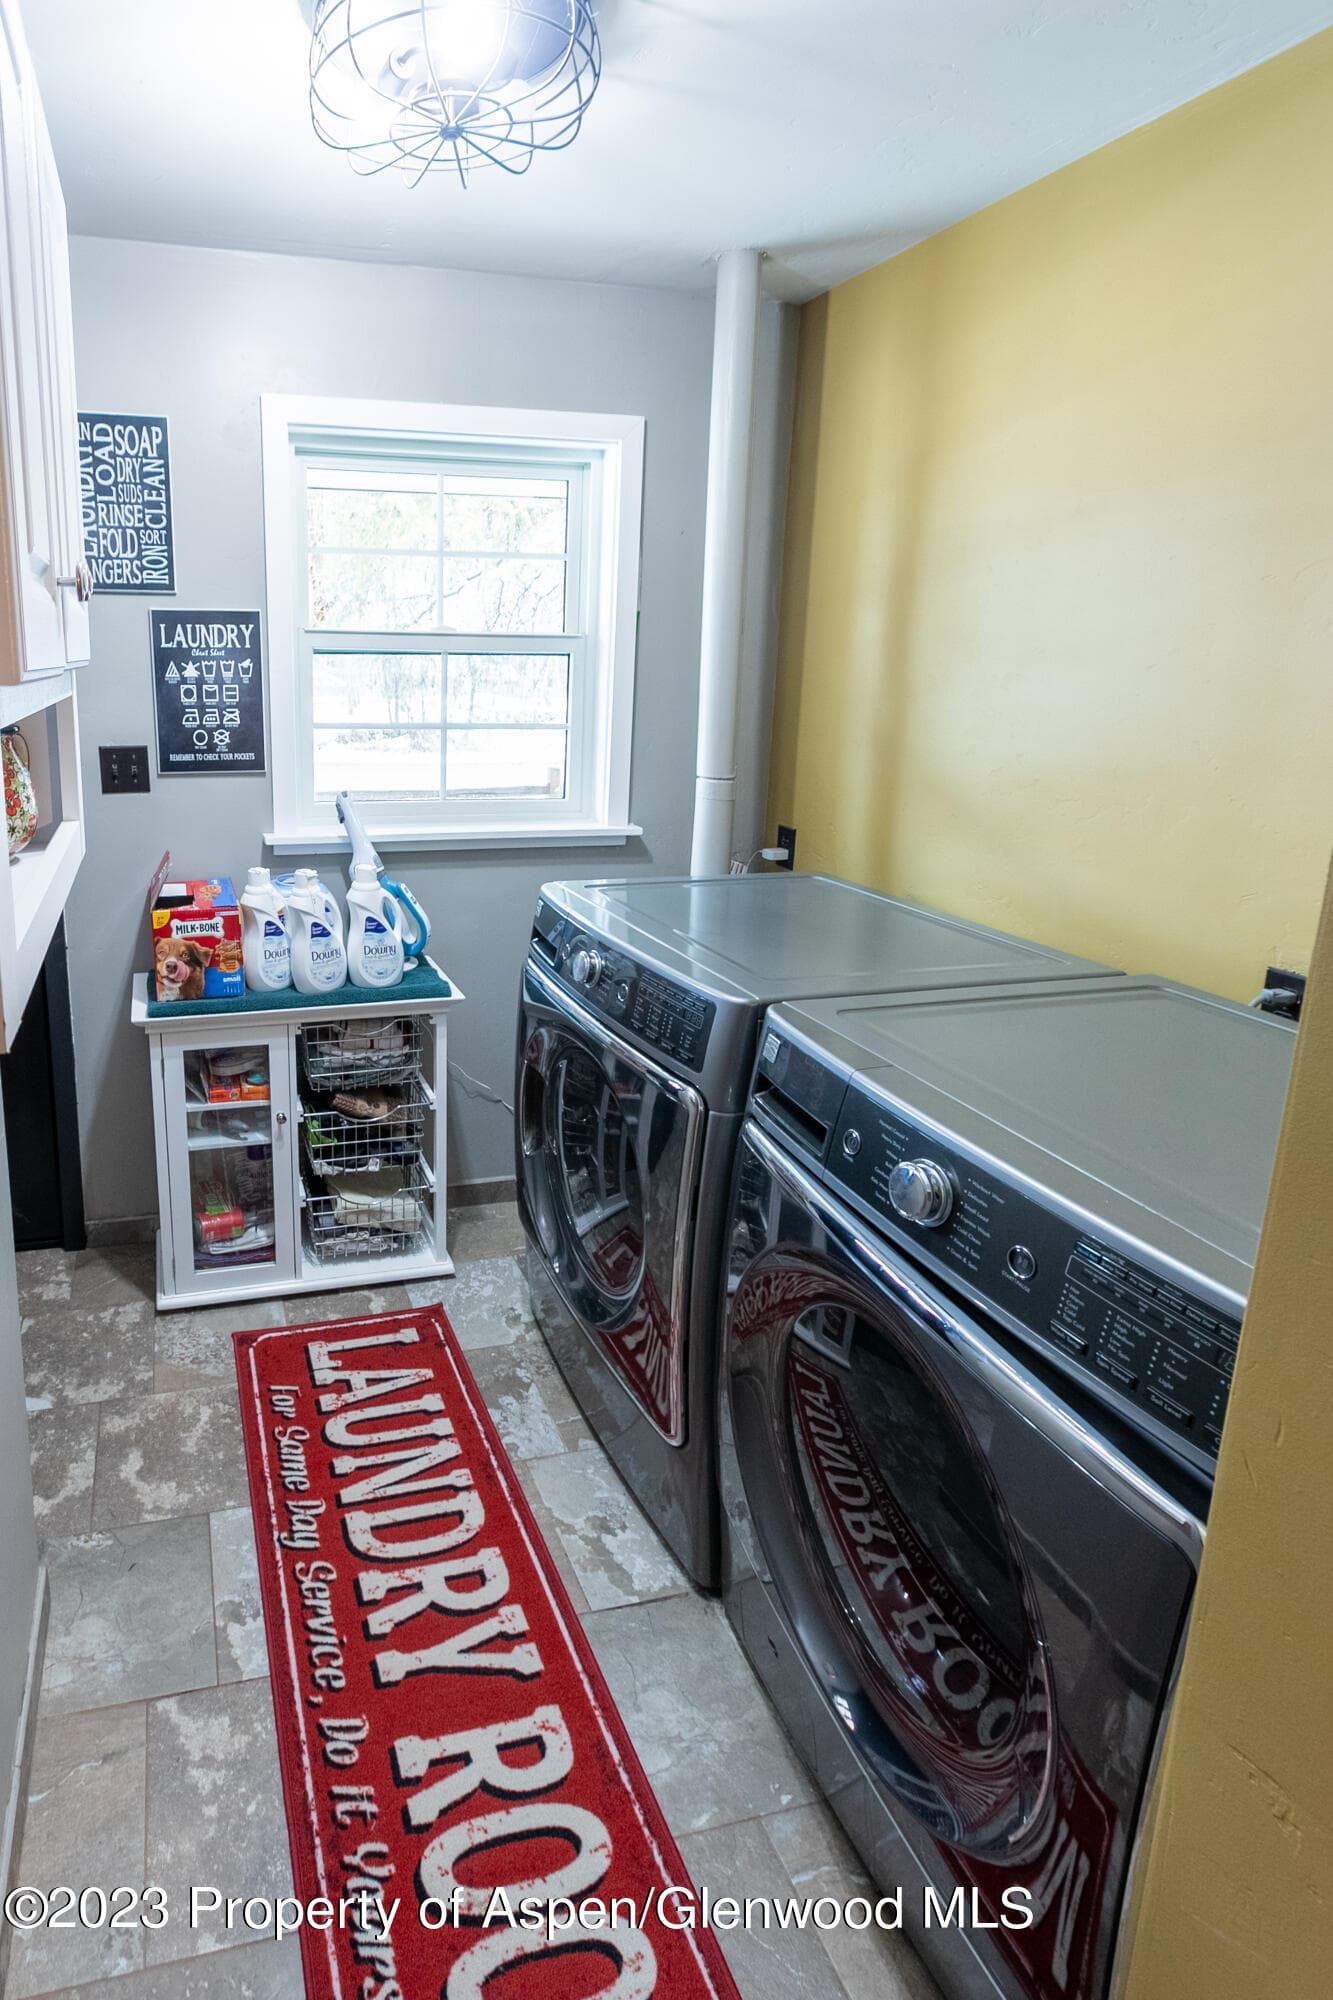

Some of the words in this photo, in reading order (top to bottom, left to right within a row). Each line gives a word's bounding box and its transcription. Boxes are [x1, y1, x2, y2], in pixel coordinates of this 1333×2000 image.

[113, 424, 163, 457] SOAP
[93, 423, 117, 503] LOAD
[116, 456, 143, 483] DRY
[117, 484, 143, 503] SUDS
[143, 458, 167, 529] CLEAN
[97, 503, 145, 528] RINSE
[98, 528, 139, 559] FOLD
[139, 529, 167, 545] SORT
[142, 545, 169, 585] IRON
[159, 623, 255, 649] LAUNDRY
[169, 753, 196, 762] REMEMBER
[196, 753, 204, 761] TO
[203, 753, 219, 761] CHECK
[220, 753, 234, 761] YOUR
[234, 752, 256, 761] POCKETS
[311, 948, 341, 961] Downy
[363, 944, 397, 956] Downy
[270, 1384, 302, 1419] For
[275, 1424, 312, 1492] Same
[306, 1327, 545, 1687] LAUNDRY
[279, 1497, 327, 1551] Day
[317, 1713, 370, 1769] Do
[329, 1784, 380, 1831] It
